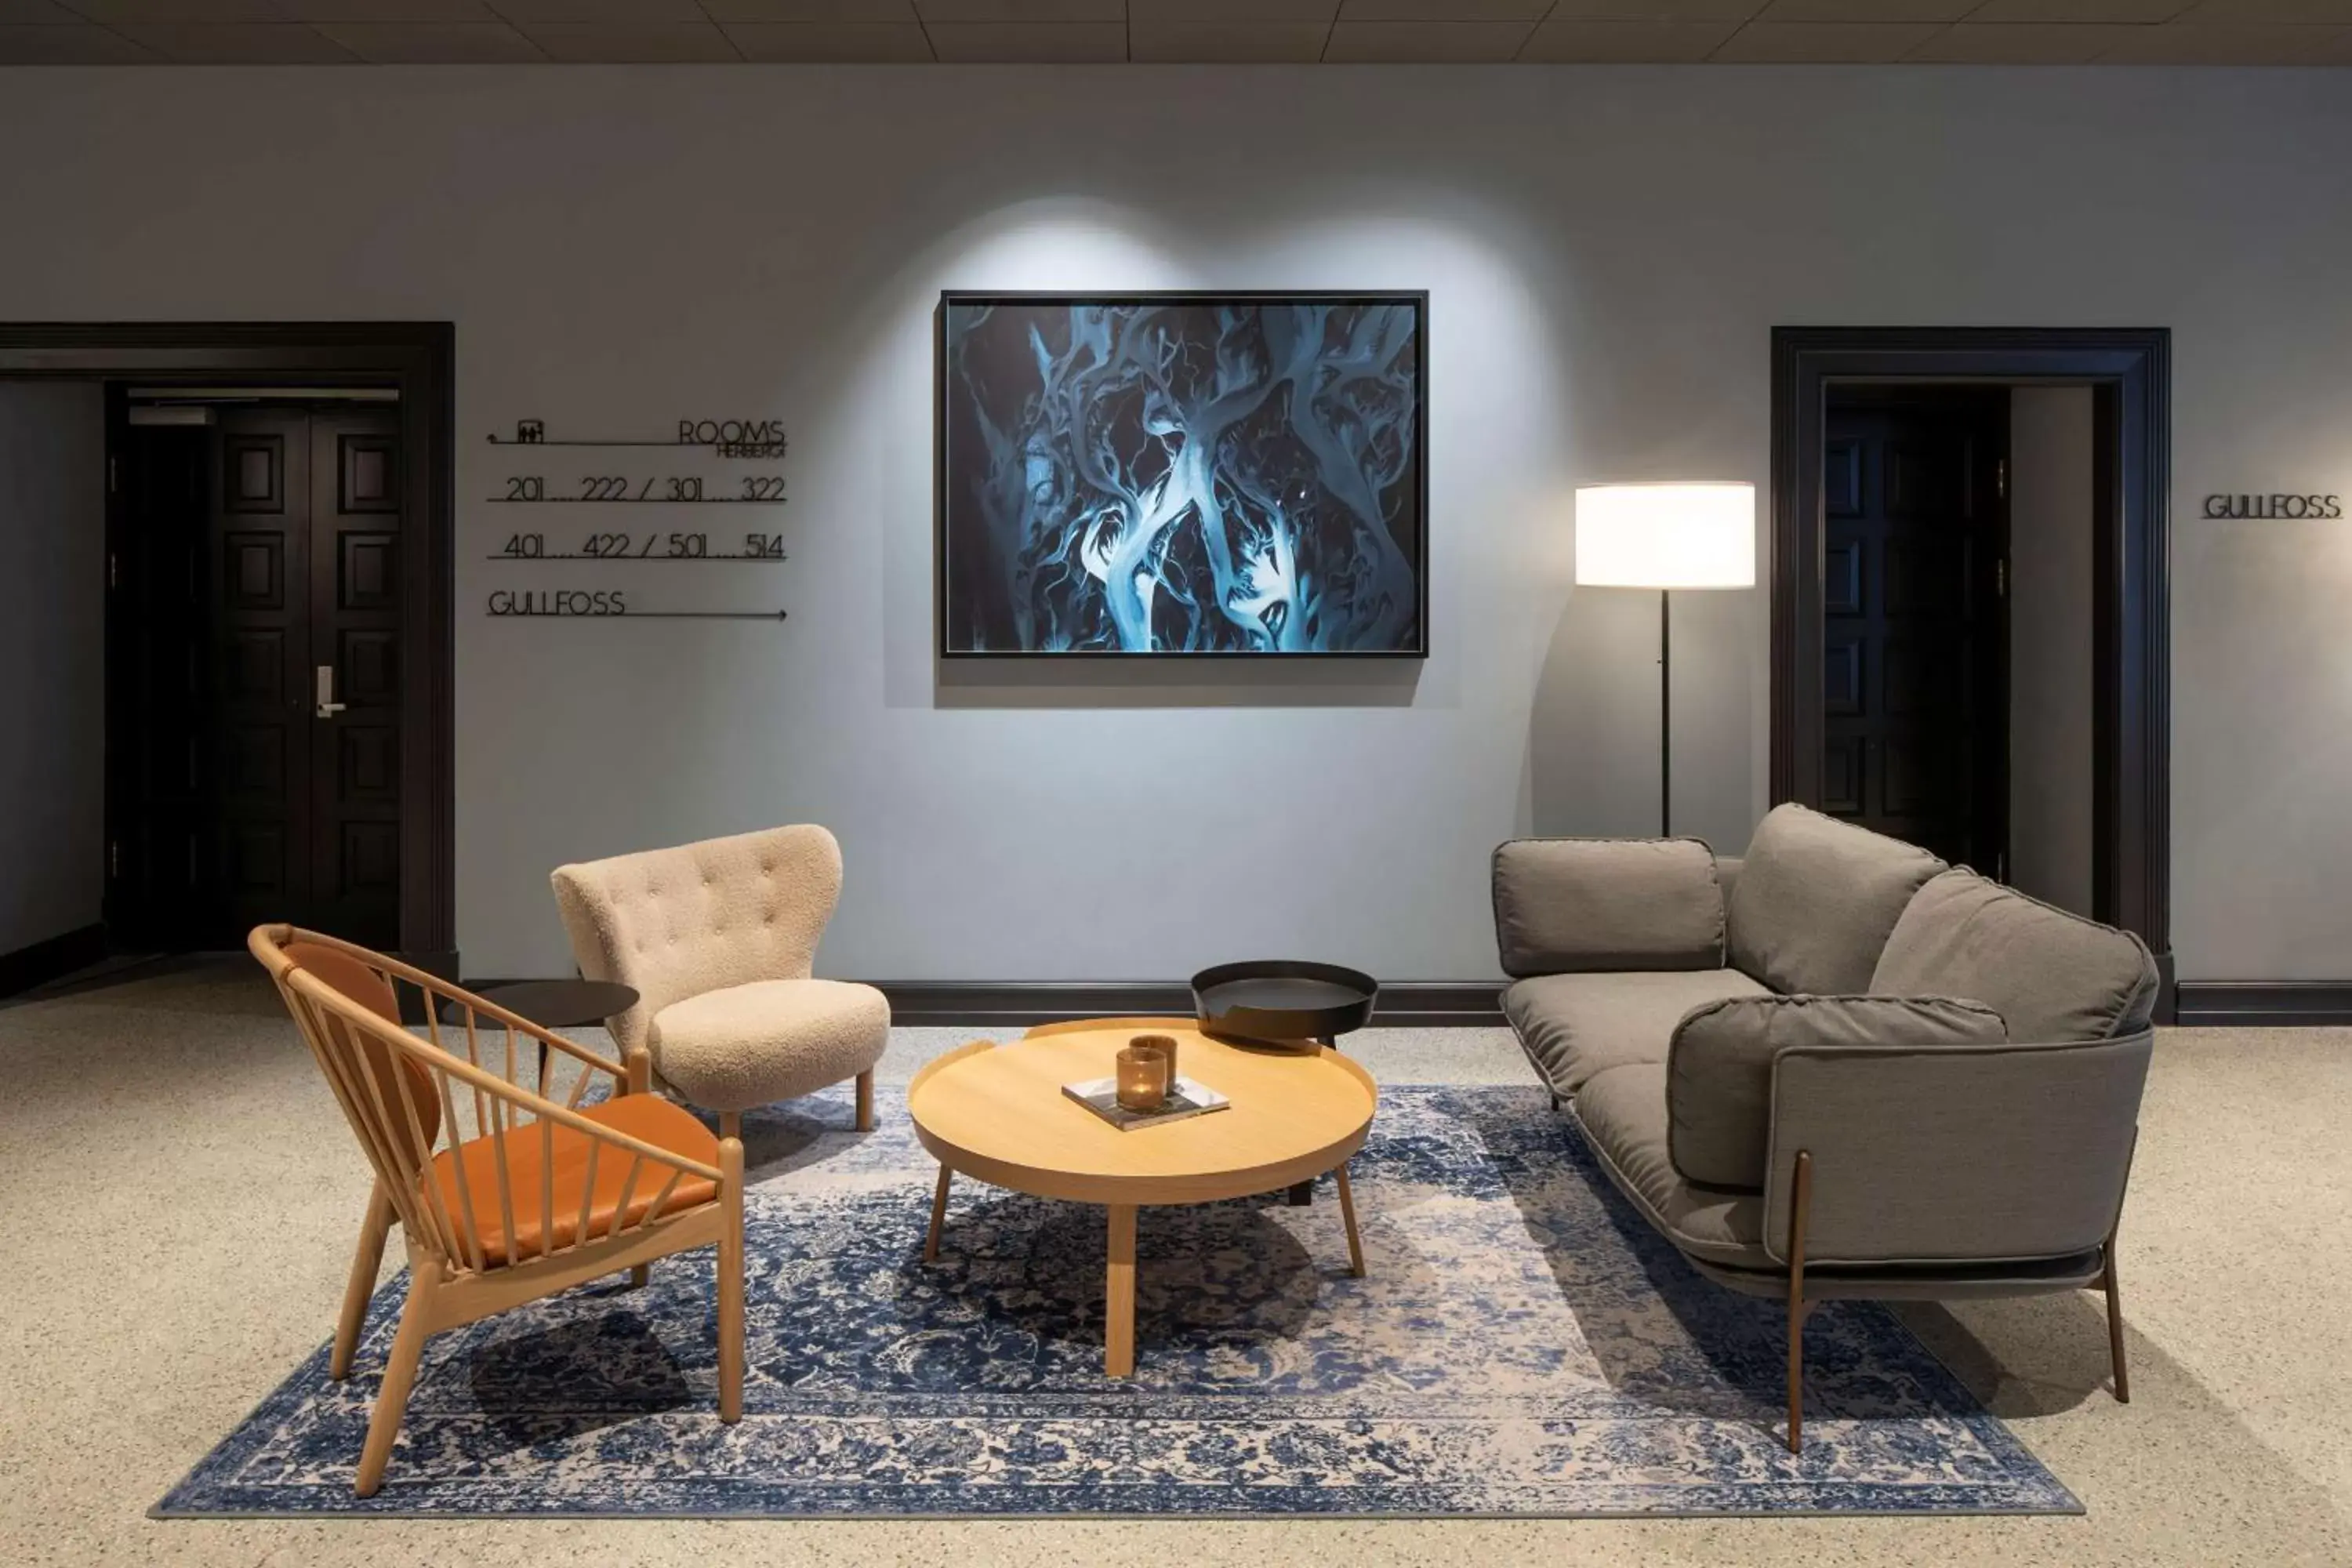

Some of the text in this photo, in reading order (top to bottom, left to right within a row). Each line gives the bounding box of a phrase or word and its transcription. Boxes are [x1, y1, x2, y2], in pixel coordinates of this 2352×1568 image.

[679, 419, 785, 445] ROOMS
[506, 476, 543, 501] 201
[581, 476, 628, 501] 222
[667, 477, 702, 502] 301
[742, 476, 785, 500] 322
[2205, 494, 2341, 519] GULLFOSS
[503, 533, 543, 558] 401
[583, 533, 630, 558] 422
[669, 533, 706, 558] 501
[746, 533, 785, 559] 514
[488, 590, 626, 615] GULLFOSS
